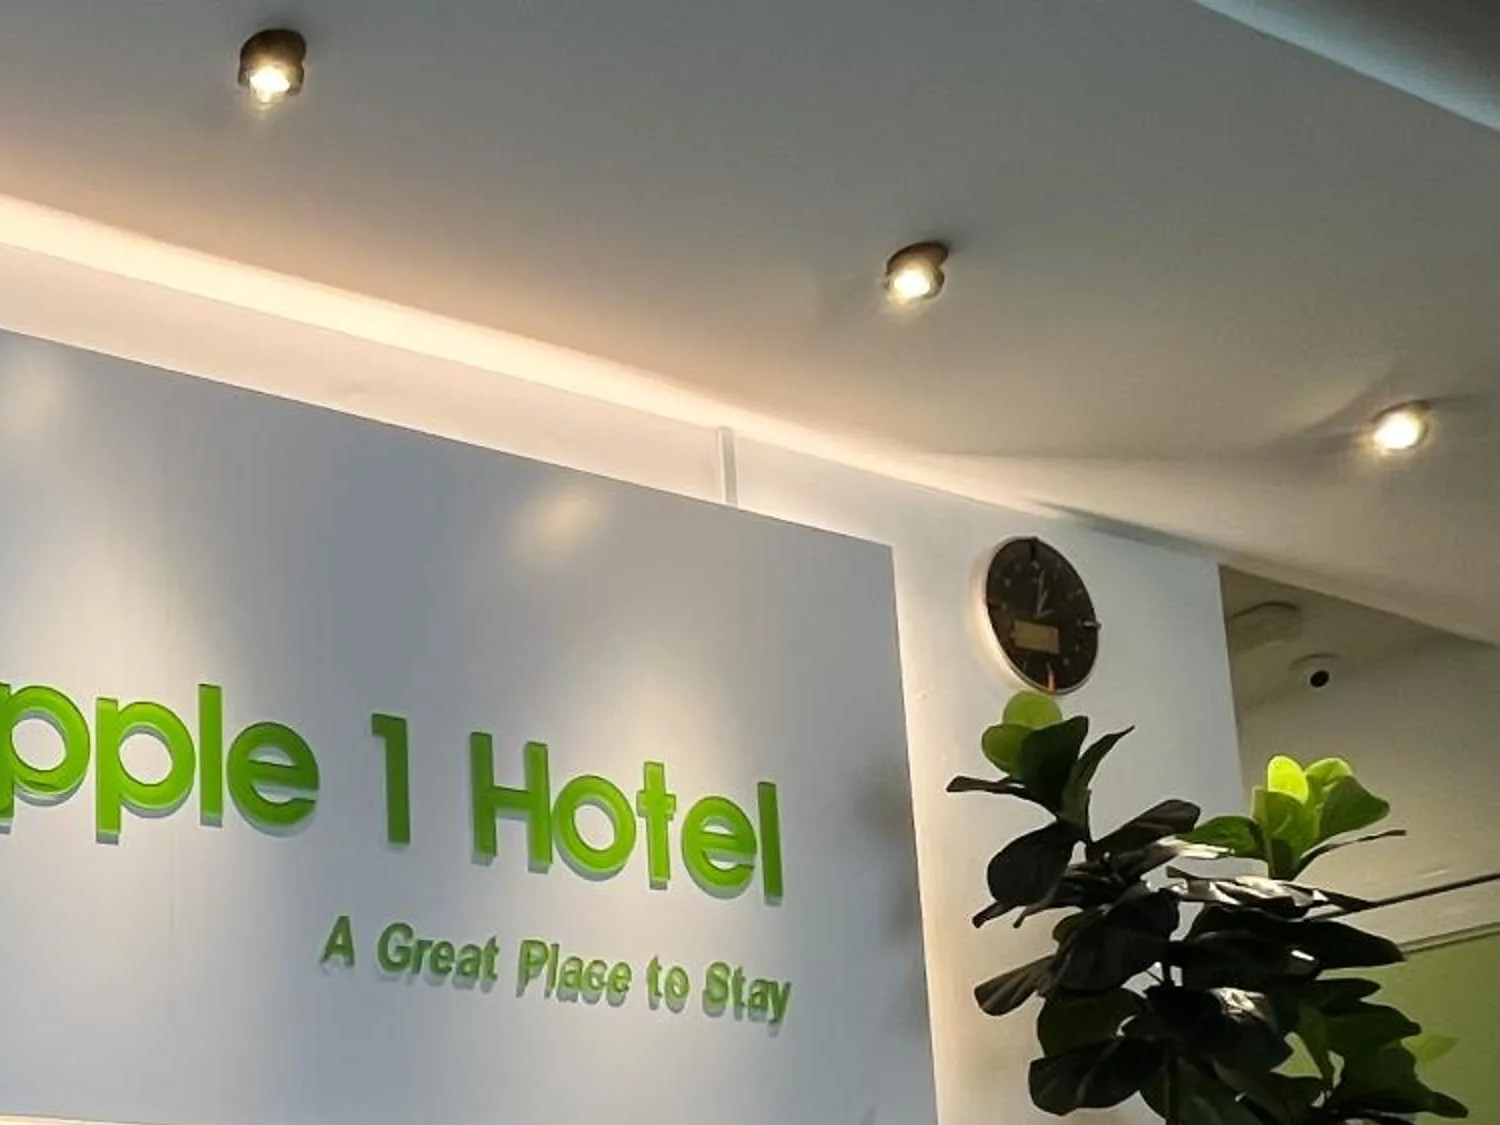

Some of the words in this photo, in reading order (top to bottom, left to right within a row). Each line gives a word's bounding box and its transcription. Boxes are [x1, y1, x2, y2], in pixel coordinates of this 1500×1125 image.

[372, 713, 409, 844] 1
[470, 731, 783, 902] Hotel
[321, 915, 355, 968] A
[376, 922, 499, 983] Great
[516, 938, 633, 997] Place
[646, 956, 690, 1002] to
[702, 960, 792, 1026] Stay
